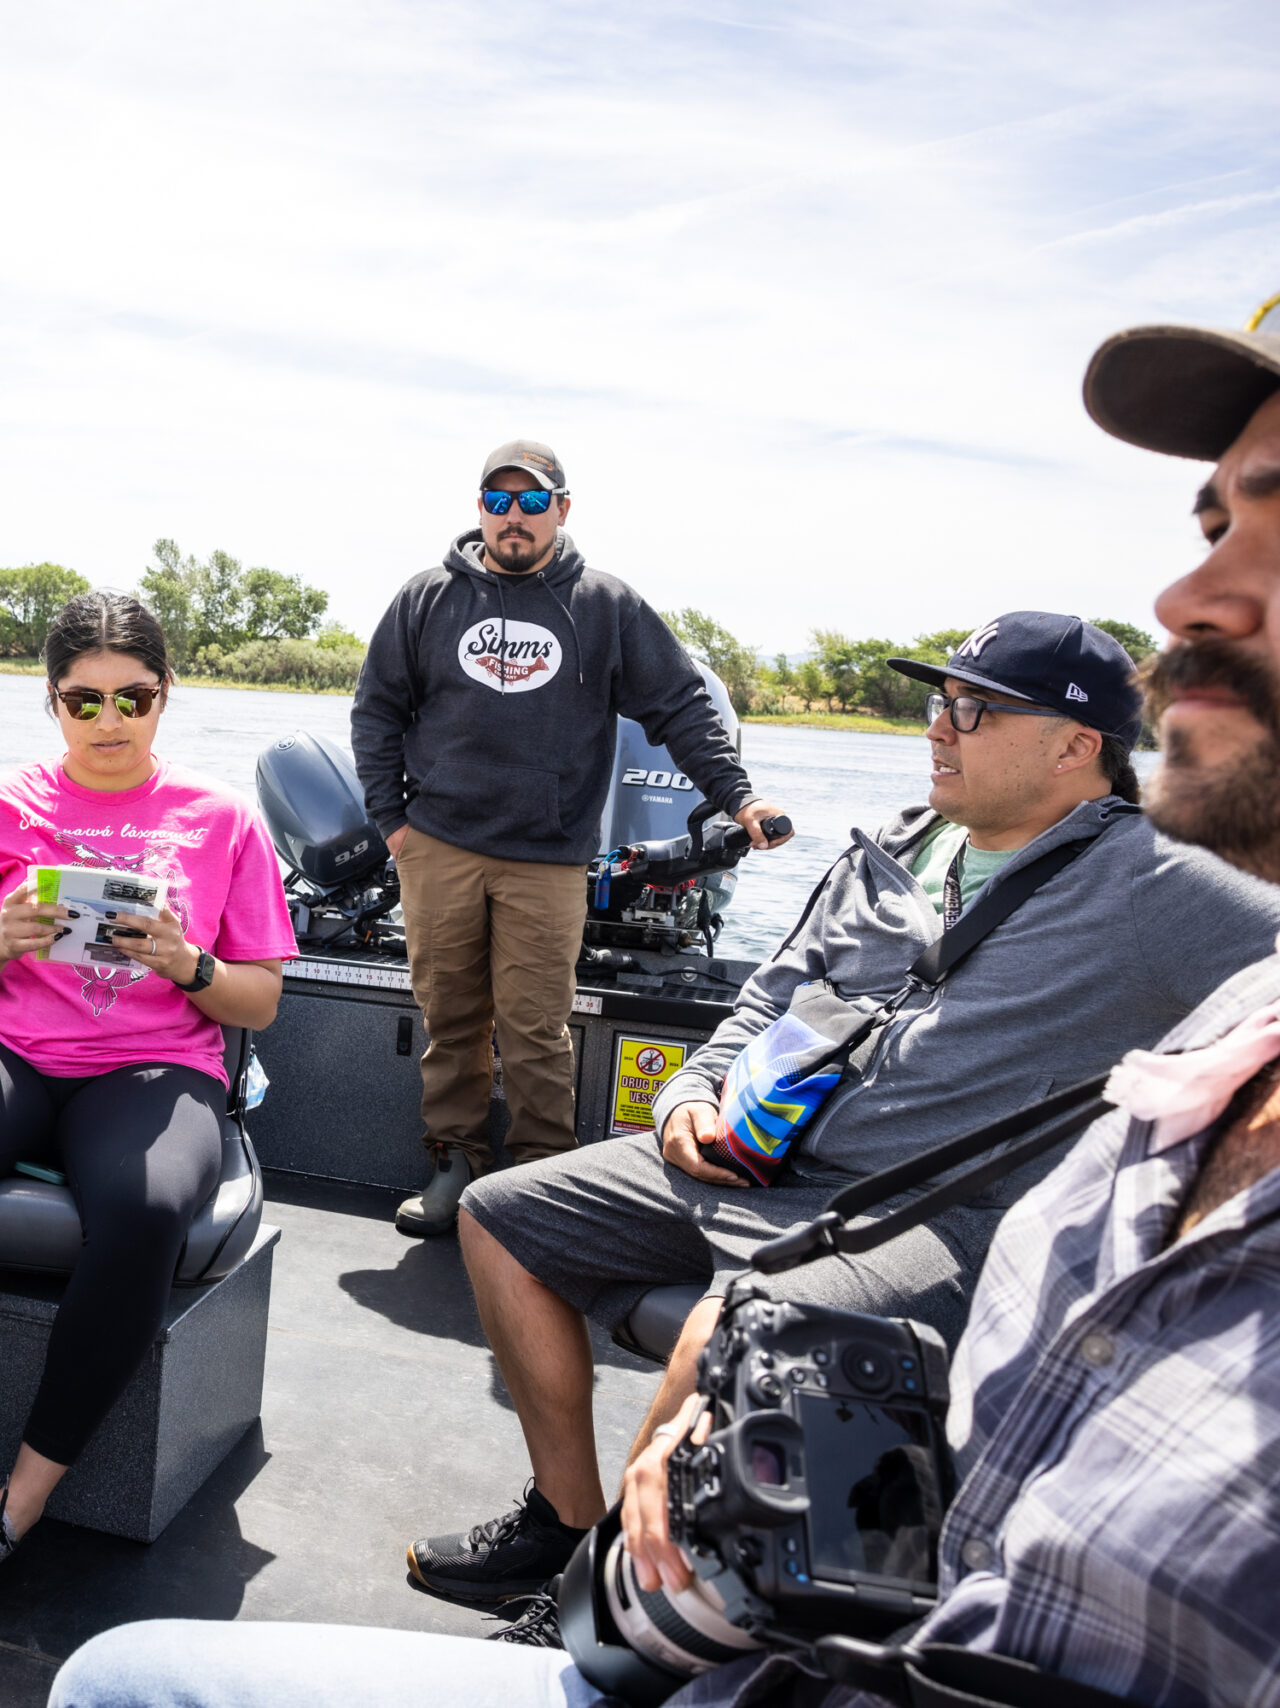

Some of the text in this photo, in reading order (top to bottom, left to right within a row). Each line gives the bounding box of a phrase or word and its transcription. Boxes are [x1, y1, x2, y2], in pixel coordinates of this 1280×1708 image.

[467, 624, 553, 658] Simms
[488, 658, 529, 676] FISHING
[622, 768, 694, 790] 200
[648, 795, 674, 804] YAMAHA
[334, 839, 369, 867] 9.9
[621, 1076, 665, 1092] DRUG FR
[630, 1091, 654, 1104] VESS
